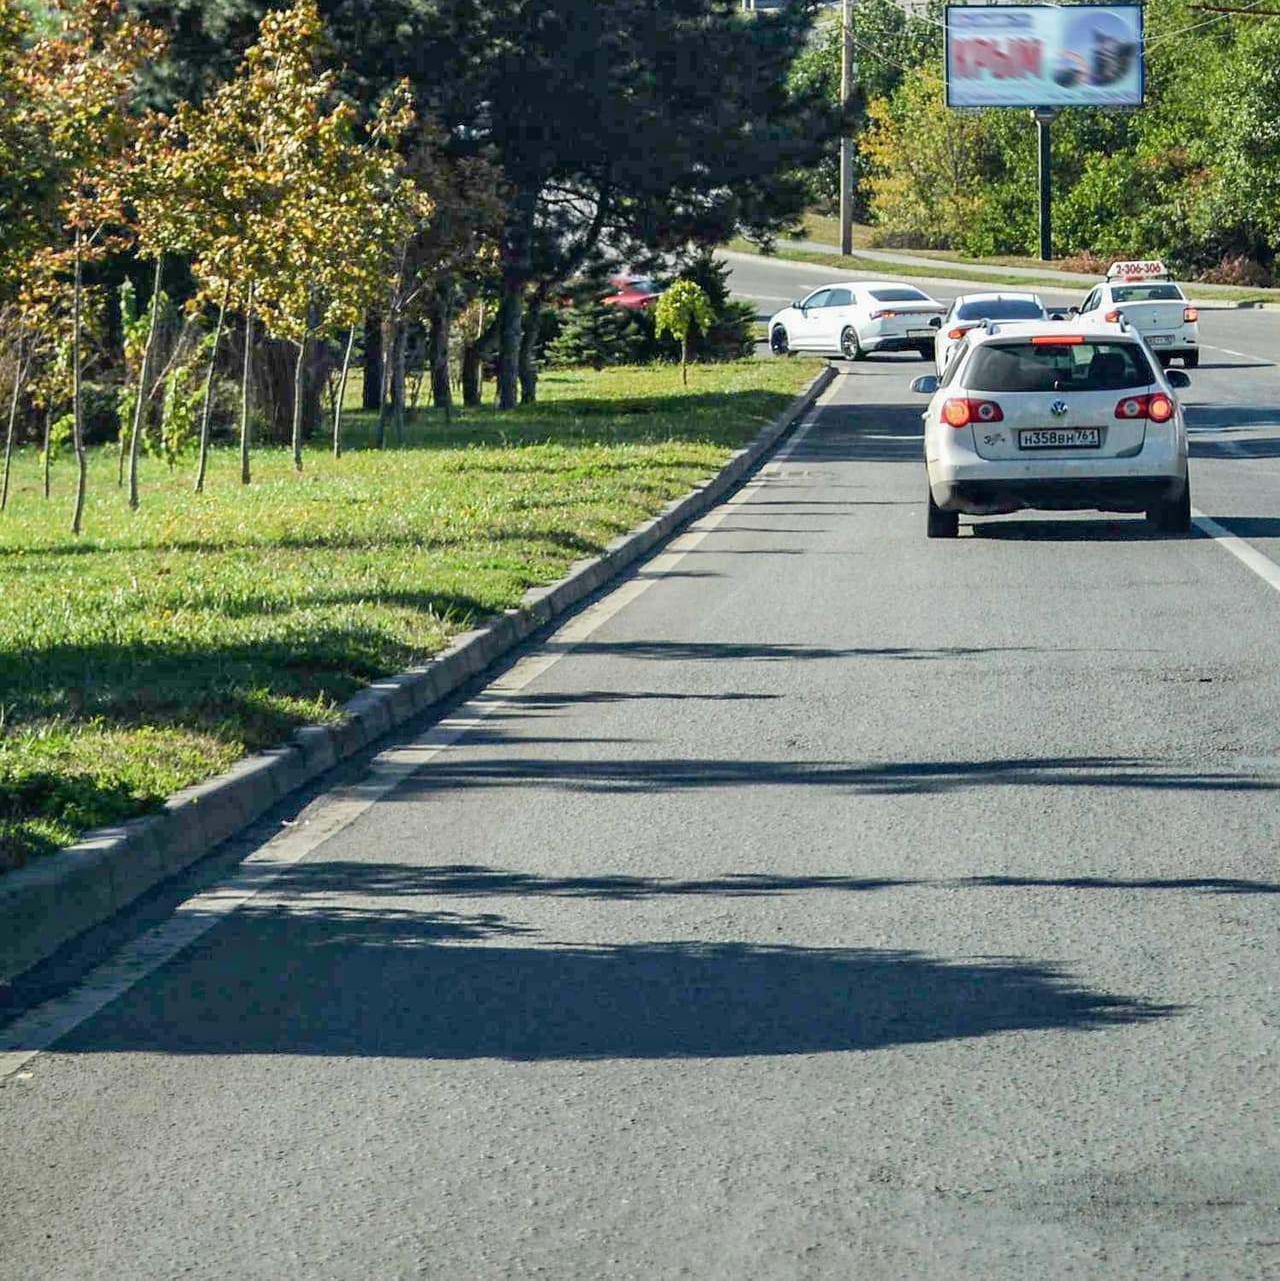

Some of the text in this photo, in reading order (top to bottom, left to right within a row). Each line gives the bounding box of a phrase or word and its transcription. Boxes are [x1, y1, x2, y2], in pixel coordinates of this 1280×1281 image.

[1115, 262, 1162, 274] 2-306-306
[1024, 430, 1096, 445] Н358ВН 761
